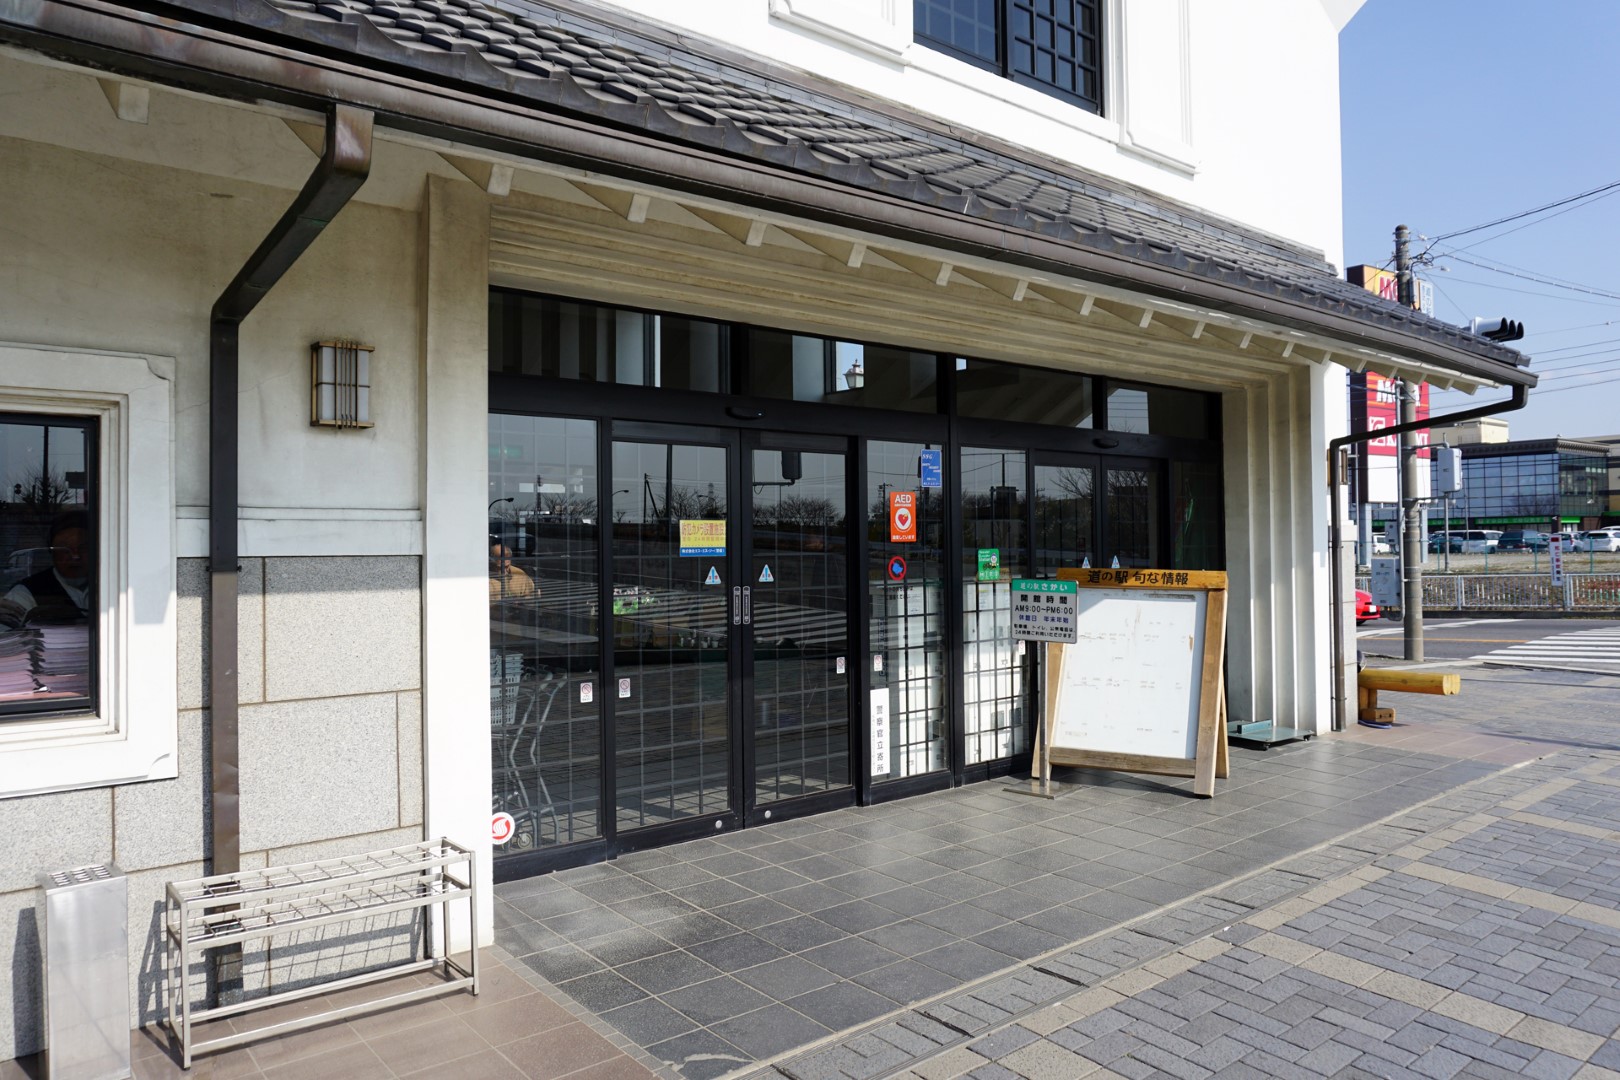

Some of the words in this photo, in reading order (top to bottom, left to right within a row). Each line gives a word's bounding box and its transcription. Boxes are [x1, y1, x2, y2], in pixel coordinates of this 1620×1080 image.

[894, 494, 912, 503] AED
[1088, 570, 1128, 584] 道の駅
[1132, 571, 1189, 585] 旬な情報
